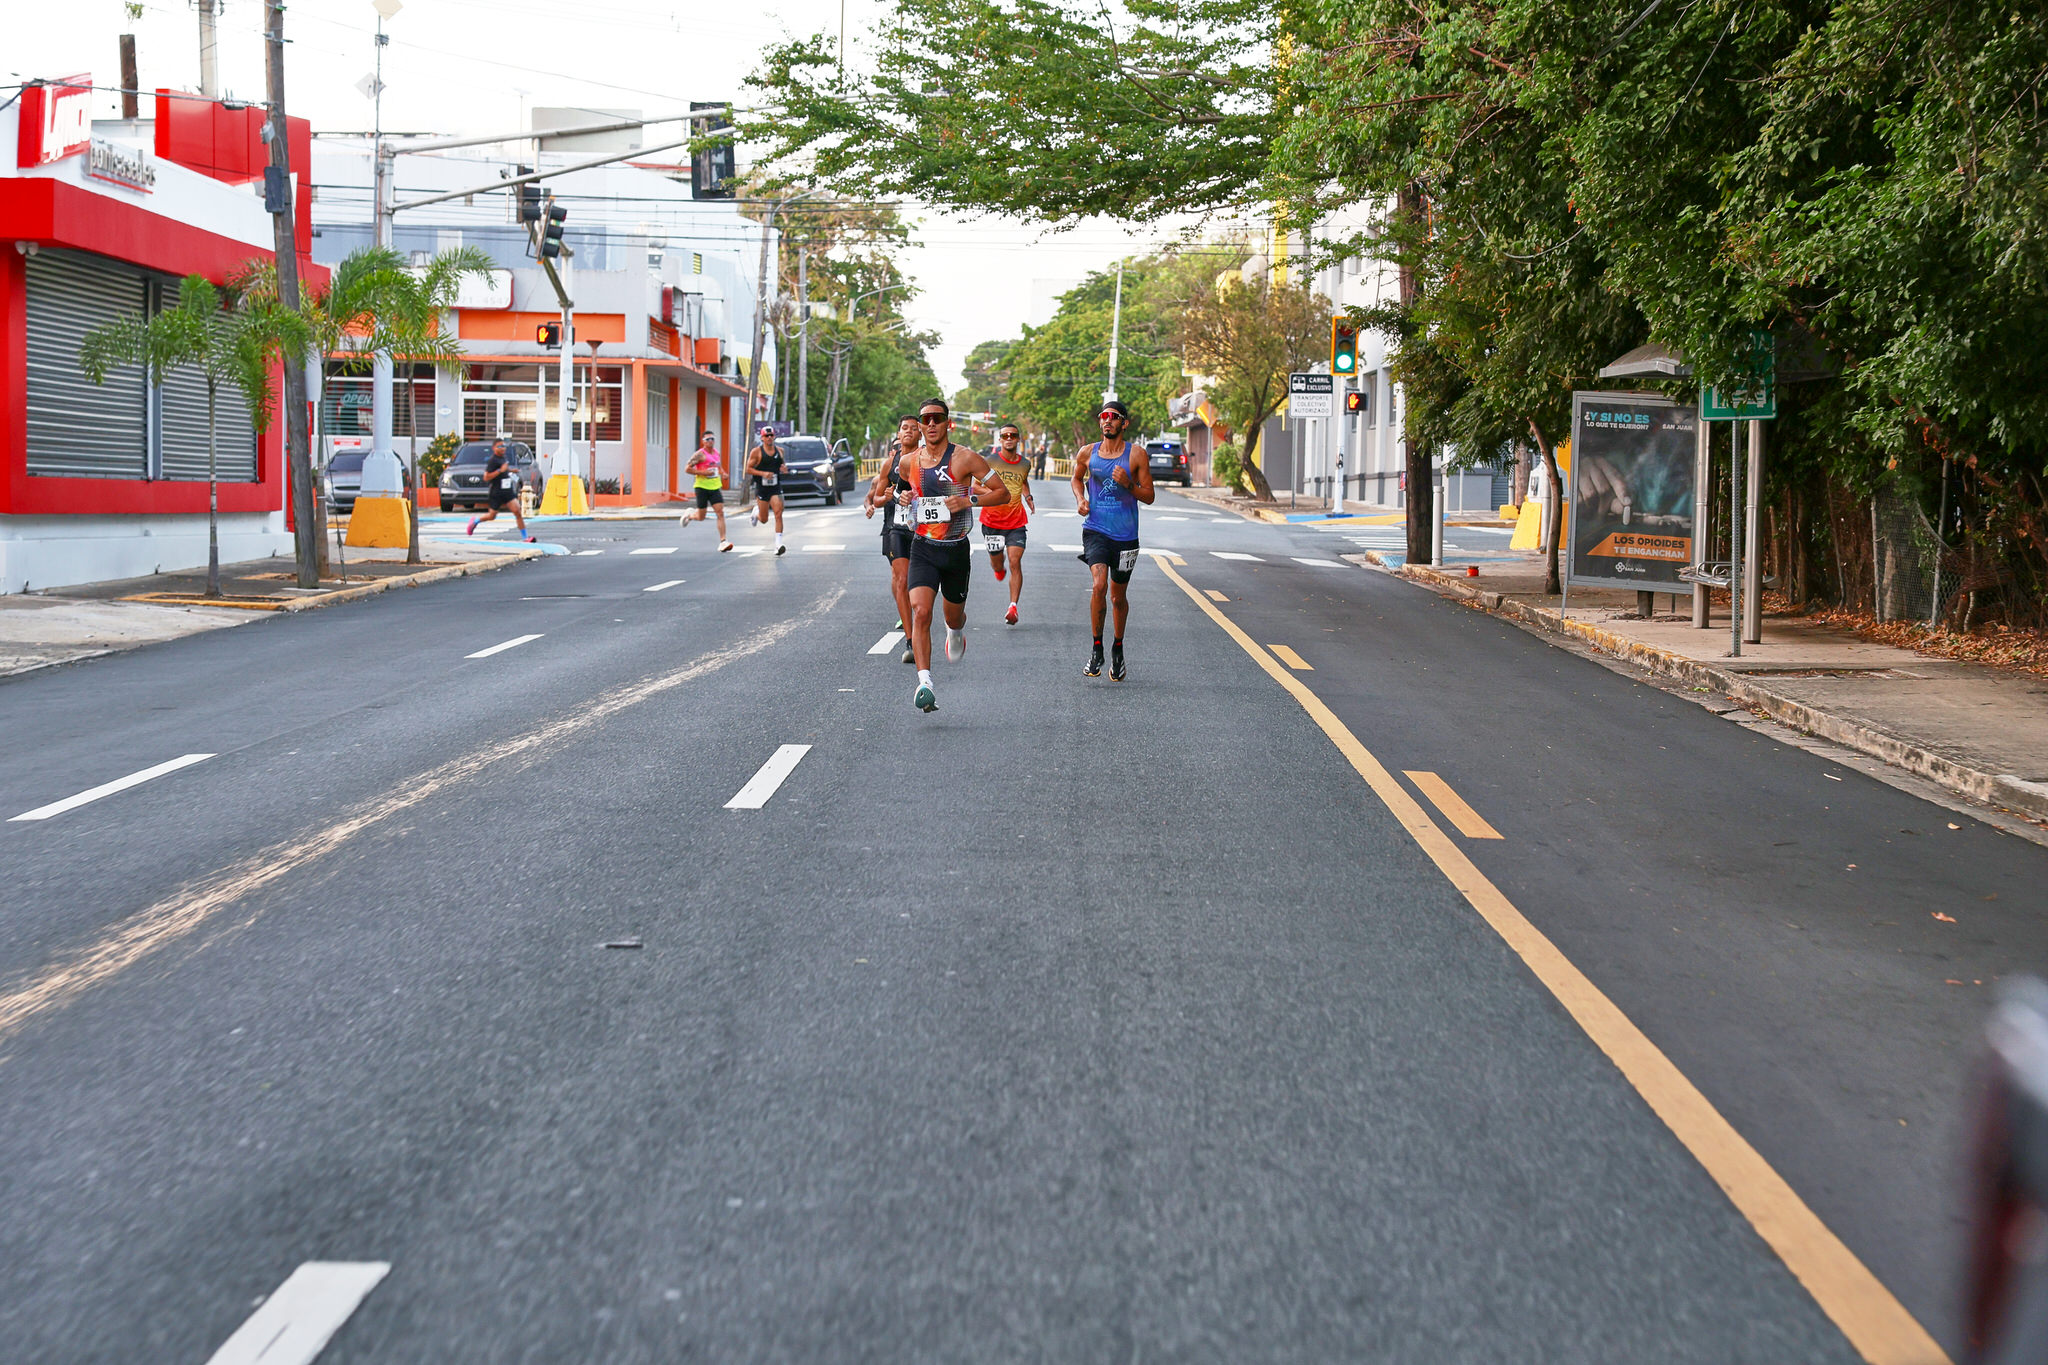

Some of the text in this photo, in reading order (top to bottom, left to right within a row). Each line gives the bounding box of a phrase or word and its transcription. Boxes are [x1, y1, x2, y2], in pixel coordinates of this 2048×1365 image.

[342, 393, 372, 405] OPEN
[1584, 411, 1650, 424] ¿Y SI NO ES
[925, 509, 938, 519] 95
[987, 543, 1000, 551] 171
[1614, 536, 1685, 549] LOS OPIOIDES
[1614, 546, 1685, 559] TE ENGANCHAN
